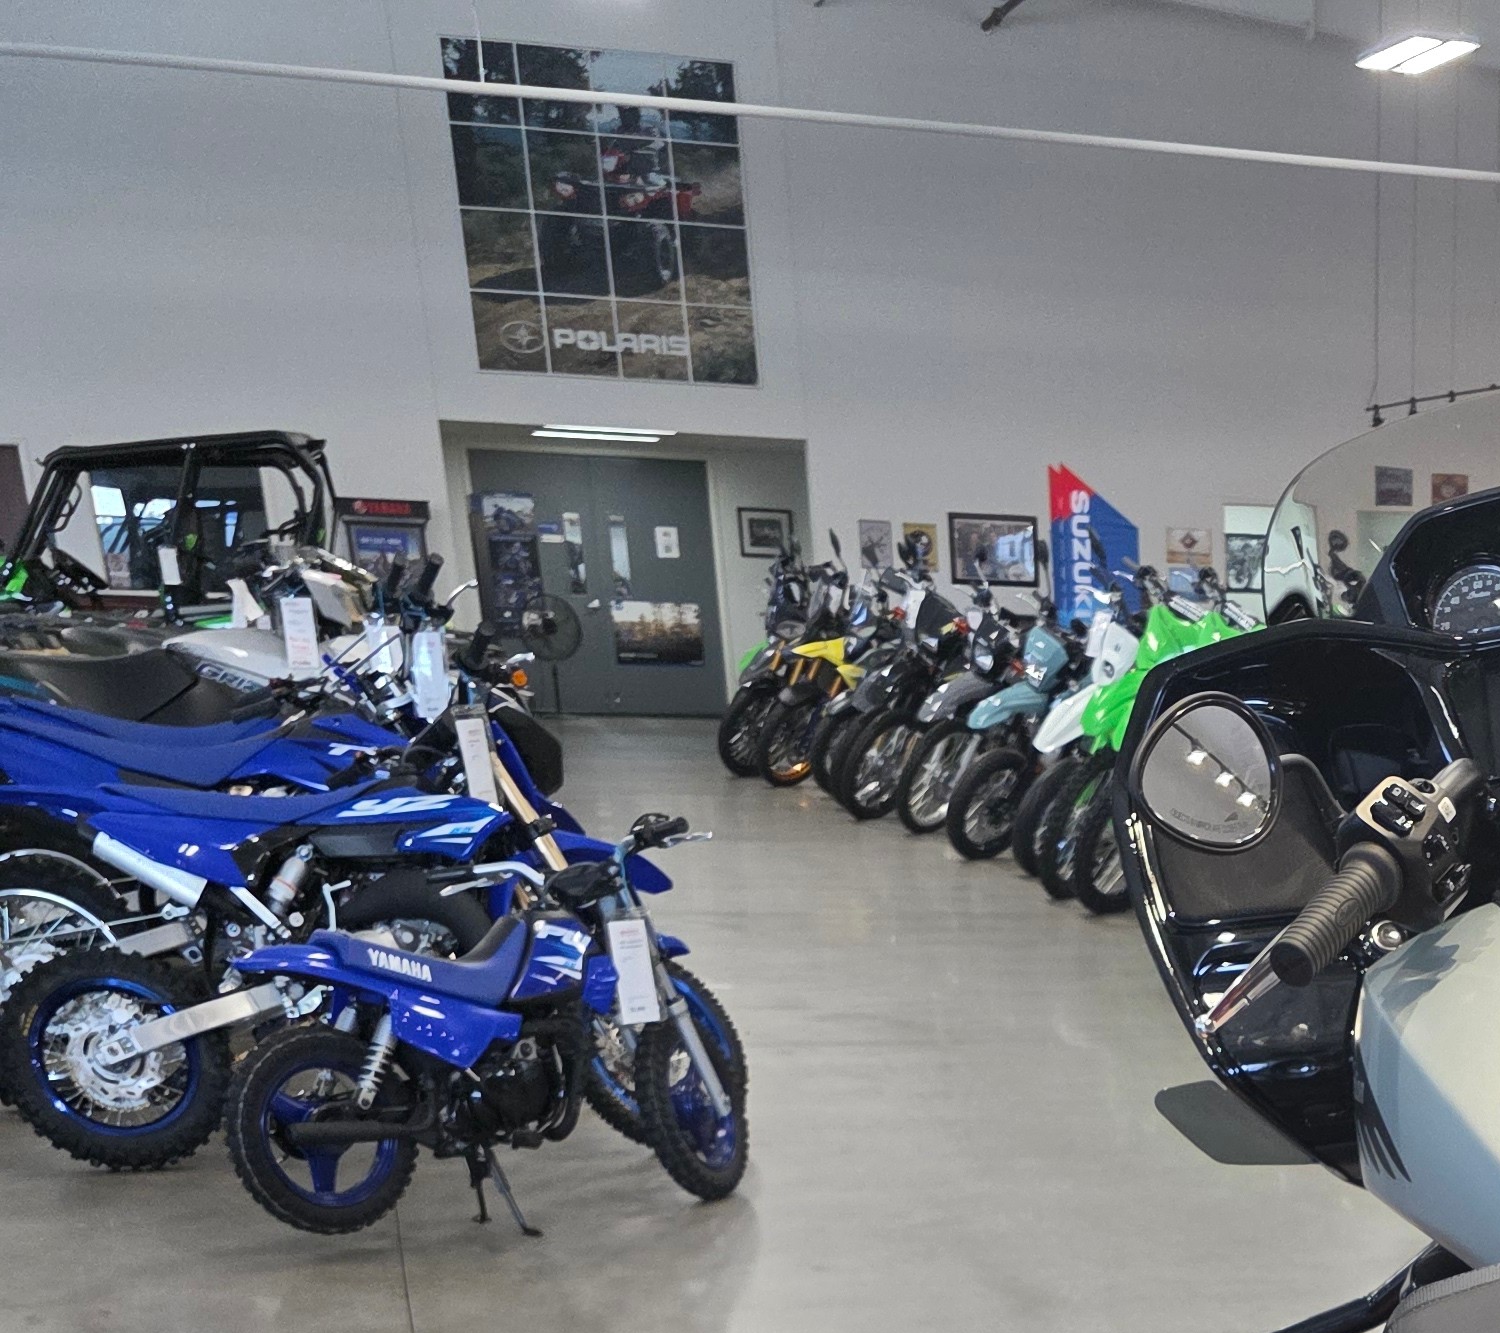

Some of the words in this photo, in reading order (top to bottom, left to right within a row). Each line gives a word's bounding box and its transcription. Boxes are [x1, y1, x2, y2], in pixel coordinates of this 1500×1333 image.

[553, 328, 691, 356] POLARIS
[1070, 489, 1093, 619] SUZUKI
[368, 947, 433, 983] YAMAHA
